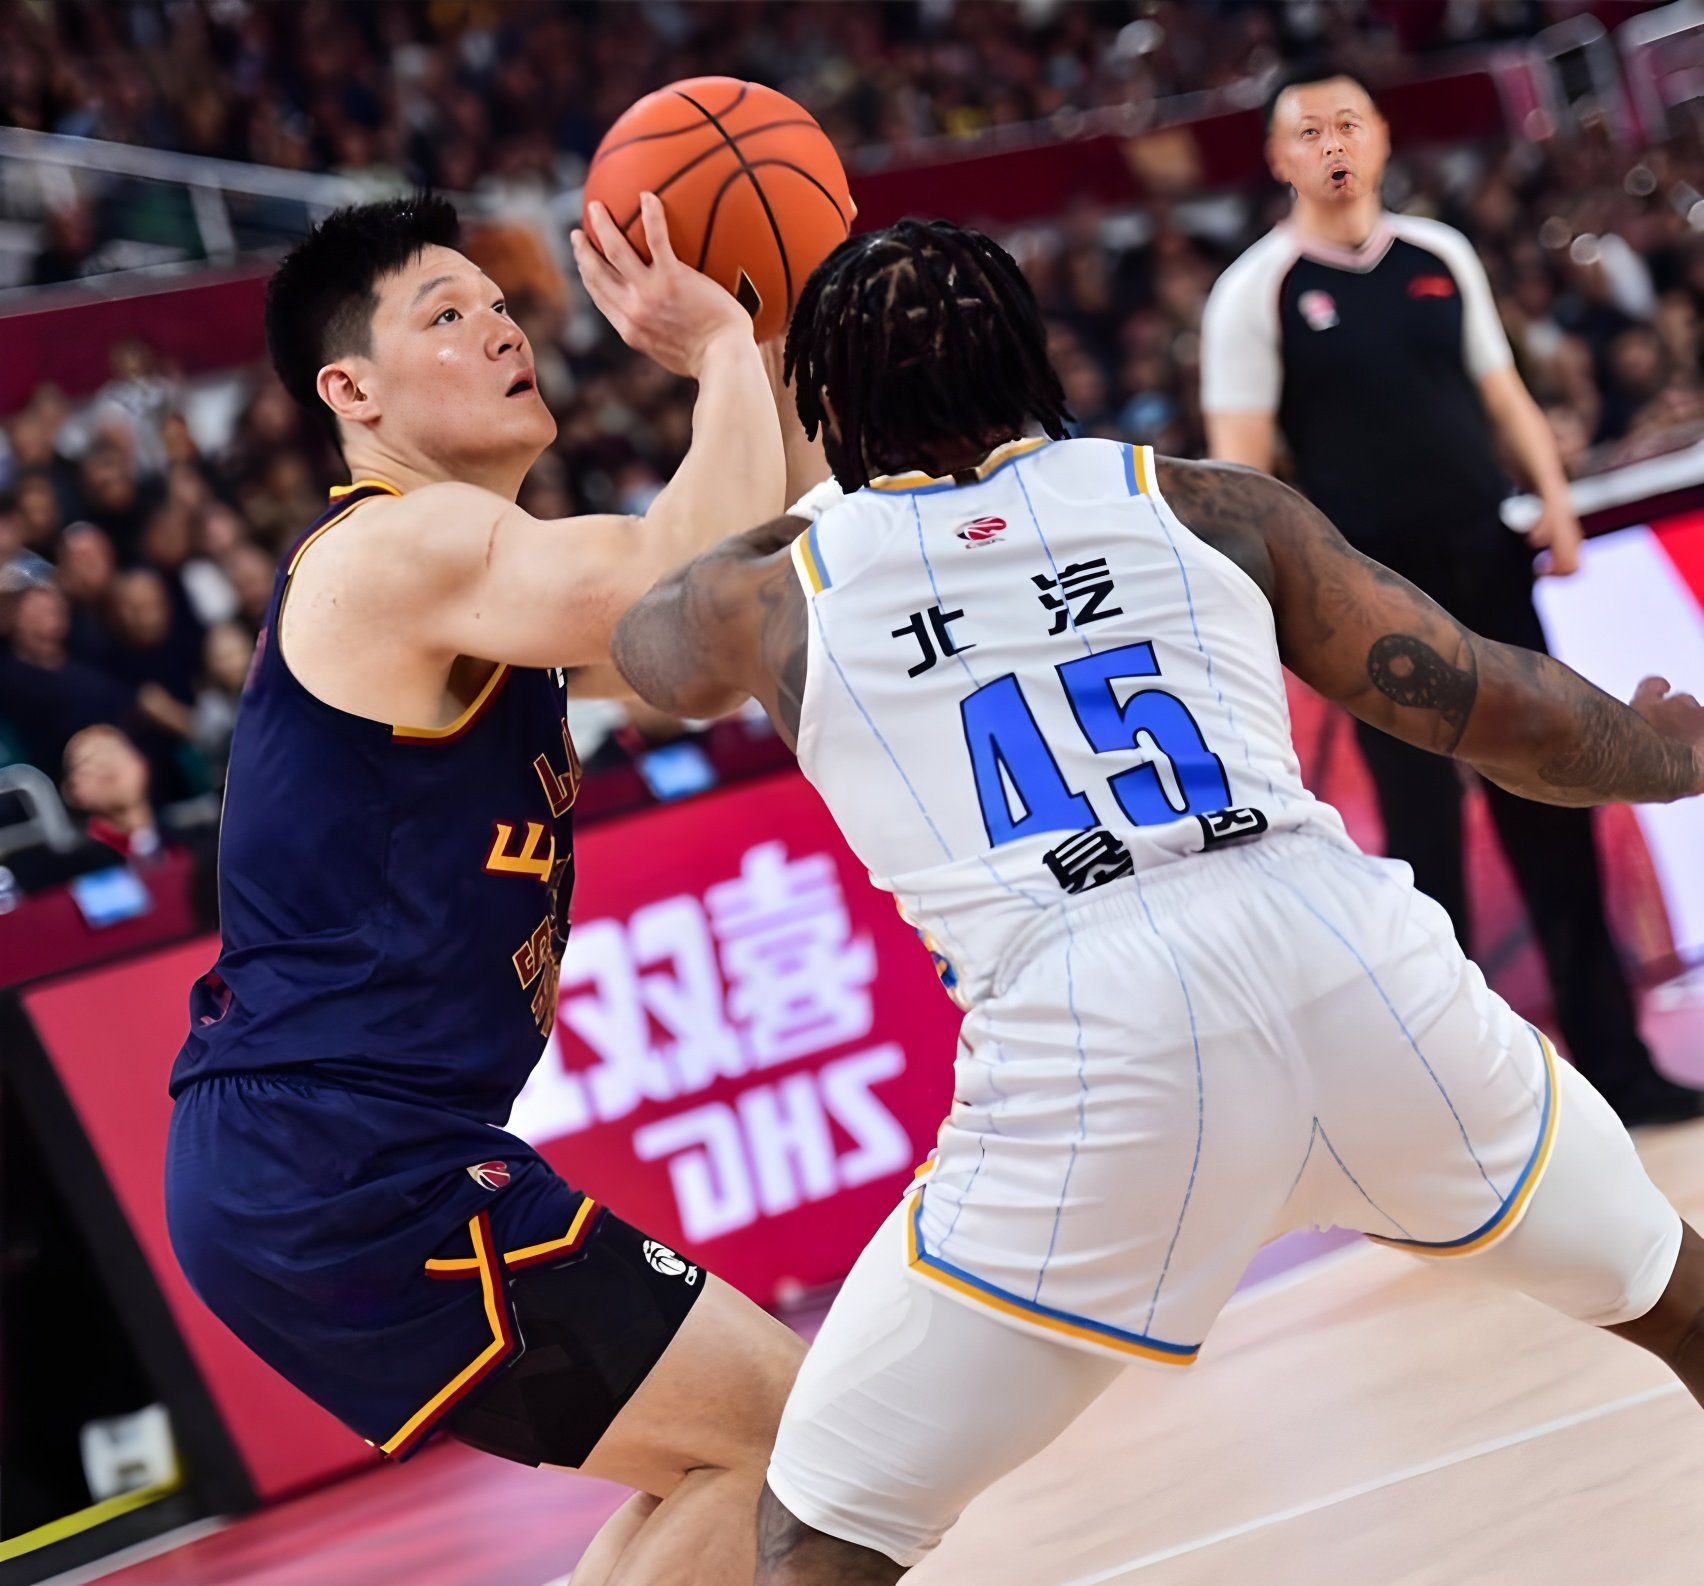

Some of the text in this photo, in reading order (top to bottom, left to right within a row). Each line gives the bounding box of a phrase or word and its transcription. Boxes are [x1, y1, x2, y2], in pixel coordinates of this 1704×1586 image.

[891, 557, 1124, 678] 北汽
[959, 640, 1233, 849] 45
[508, 839, 878, 1143] 双喜
[632, 1041, 913, 1244] DHS
